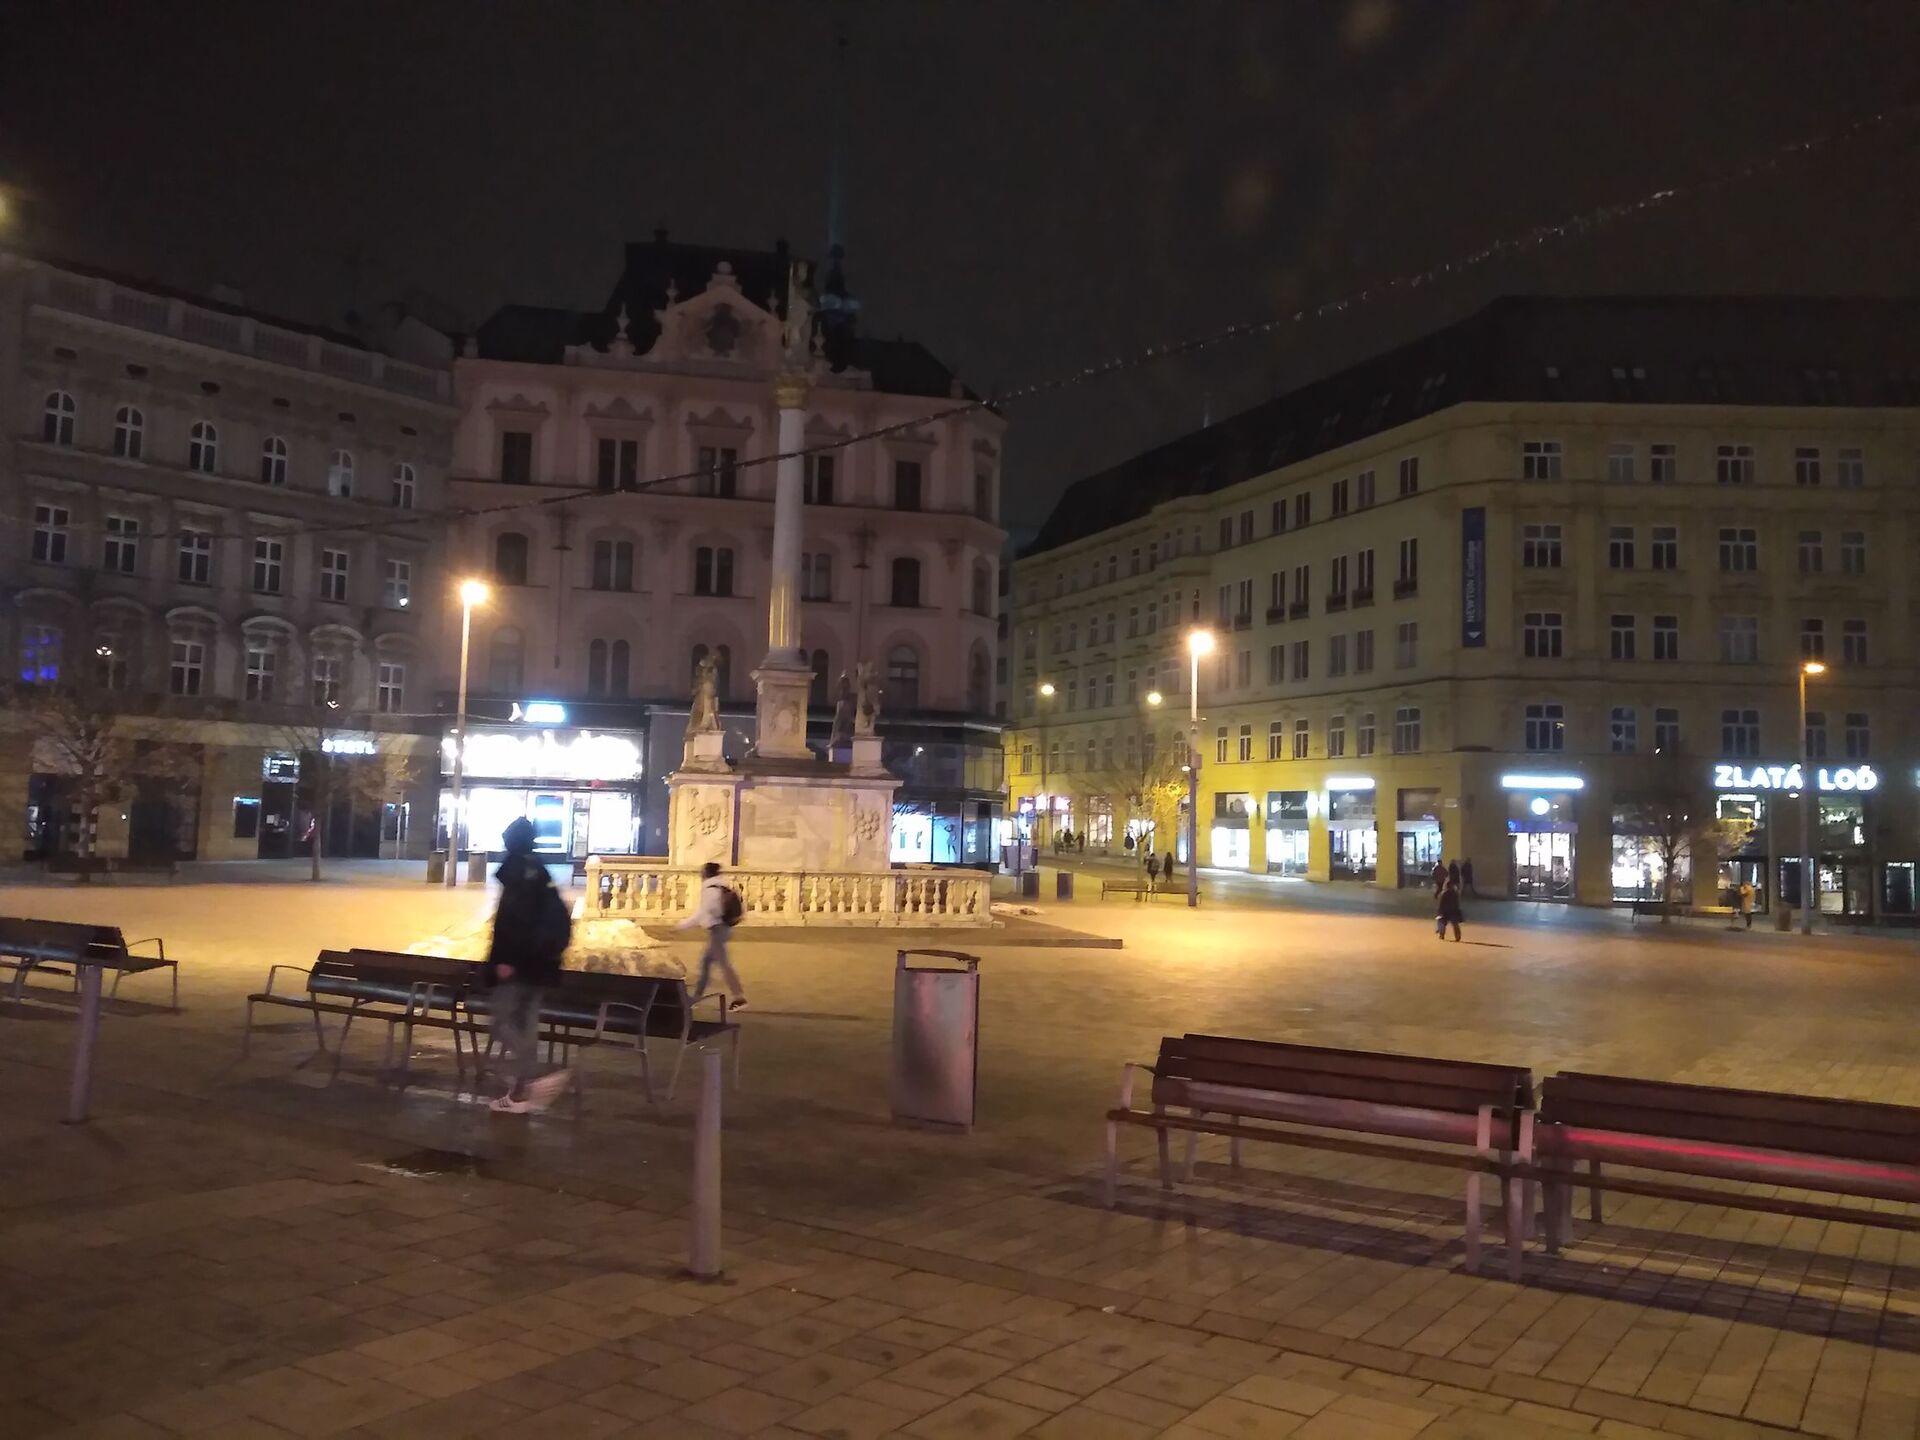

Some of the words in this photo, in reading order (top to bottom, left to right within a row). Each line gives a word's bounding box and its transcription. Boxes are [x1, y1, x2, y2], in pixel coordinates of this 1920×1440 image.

[1466, 579, 1475, 623] NEWTON
[1714, 764, 1803, 789] ZLATÁ
[1819, 765, 1878, 790] LOĎ
